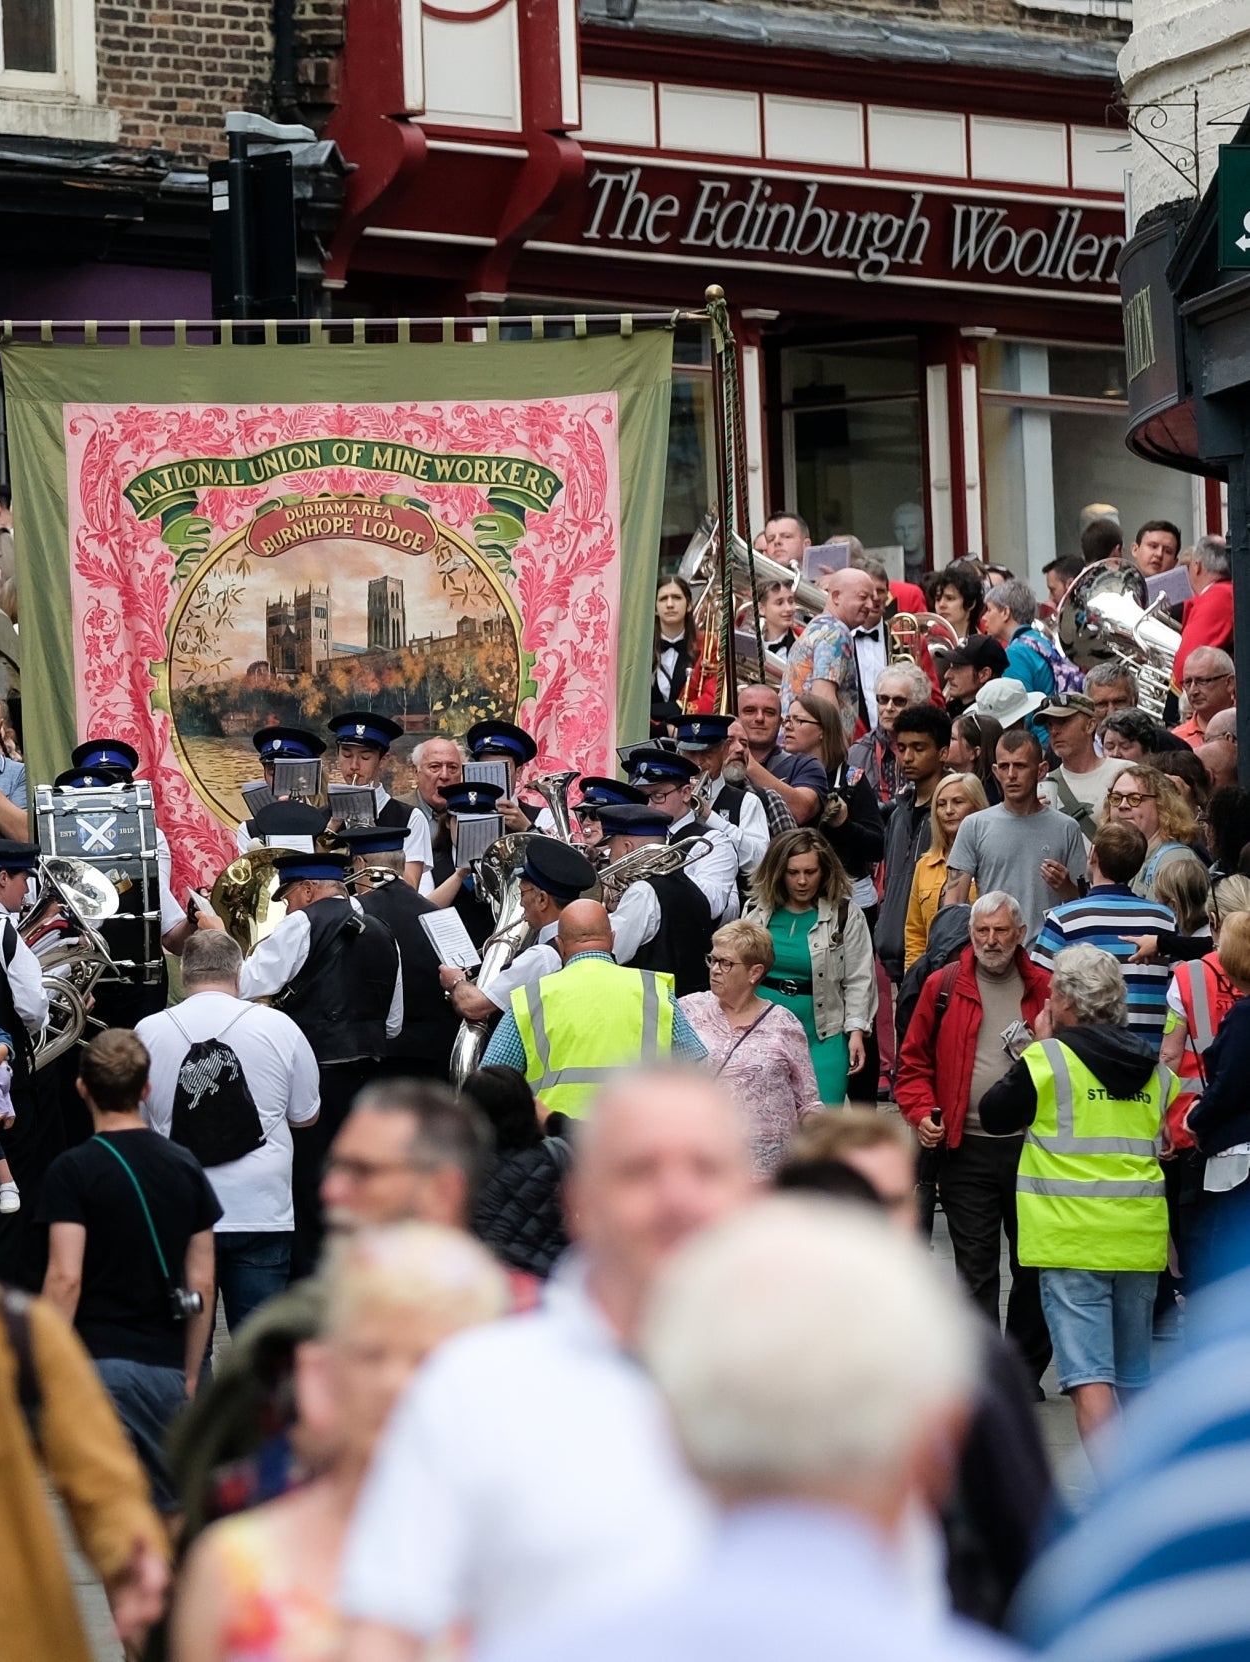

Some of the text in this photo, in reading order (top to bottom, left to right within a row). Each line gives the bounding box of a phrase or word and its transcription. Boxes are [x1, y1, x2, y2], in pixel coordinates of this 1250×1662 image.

[582, 167, 1126, 284] The Edinburgh Woollen
[129, 462, 245, 508] NATIONAL
[249, 444, 321, 482] UNION
[332, 442, 366, 465] OF
[259, 517, 427, 555] BURNHOPE LODGE
[284, 502, 393, 523] DURHAM AREA
